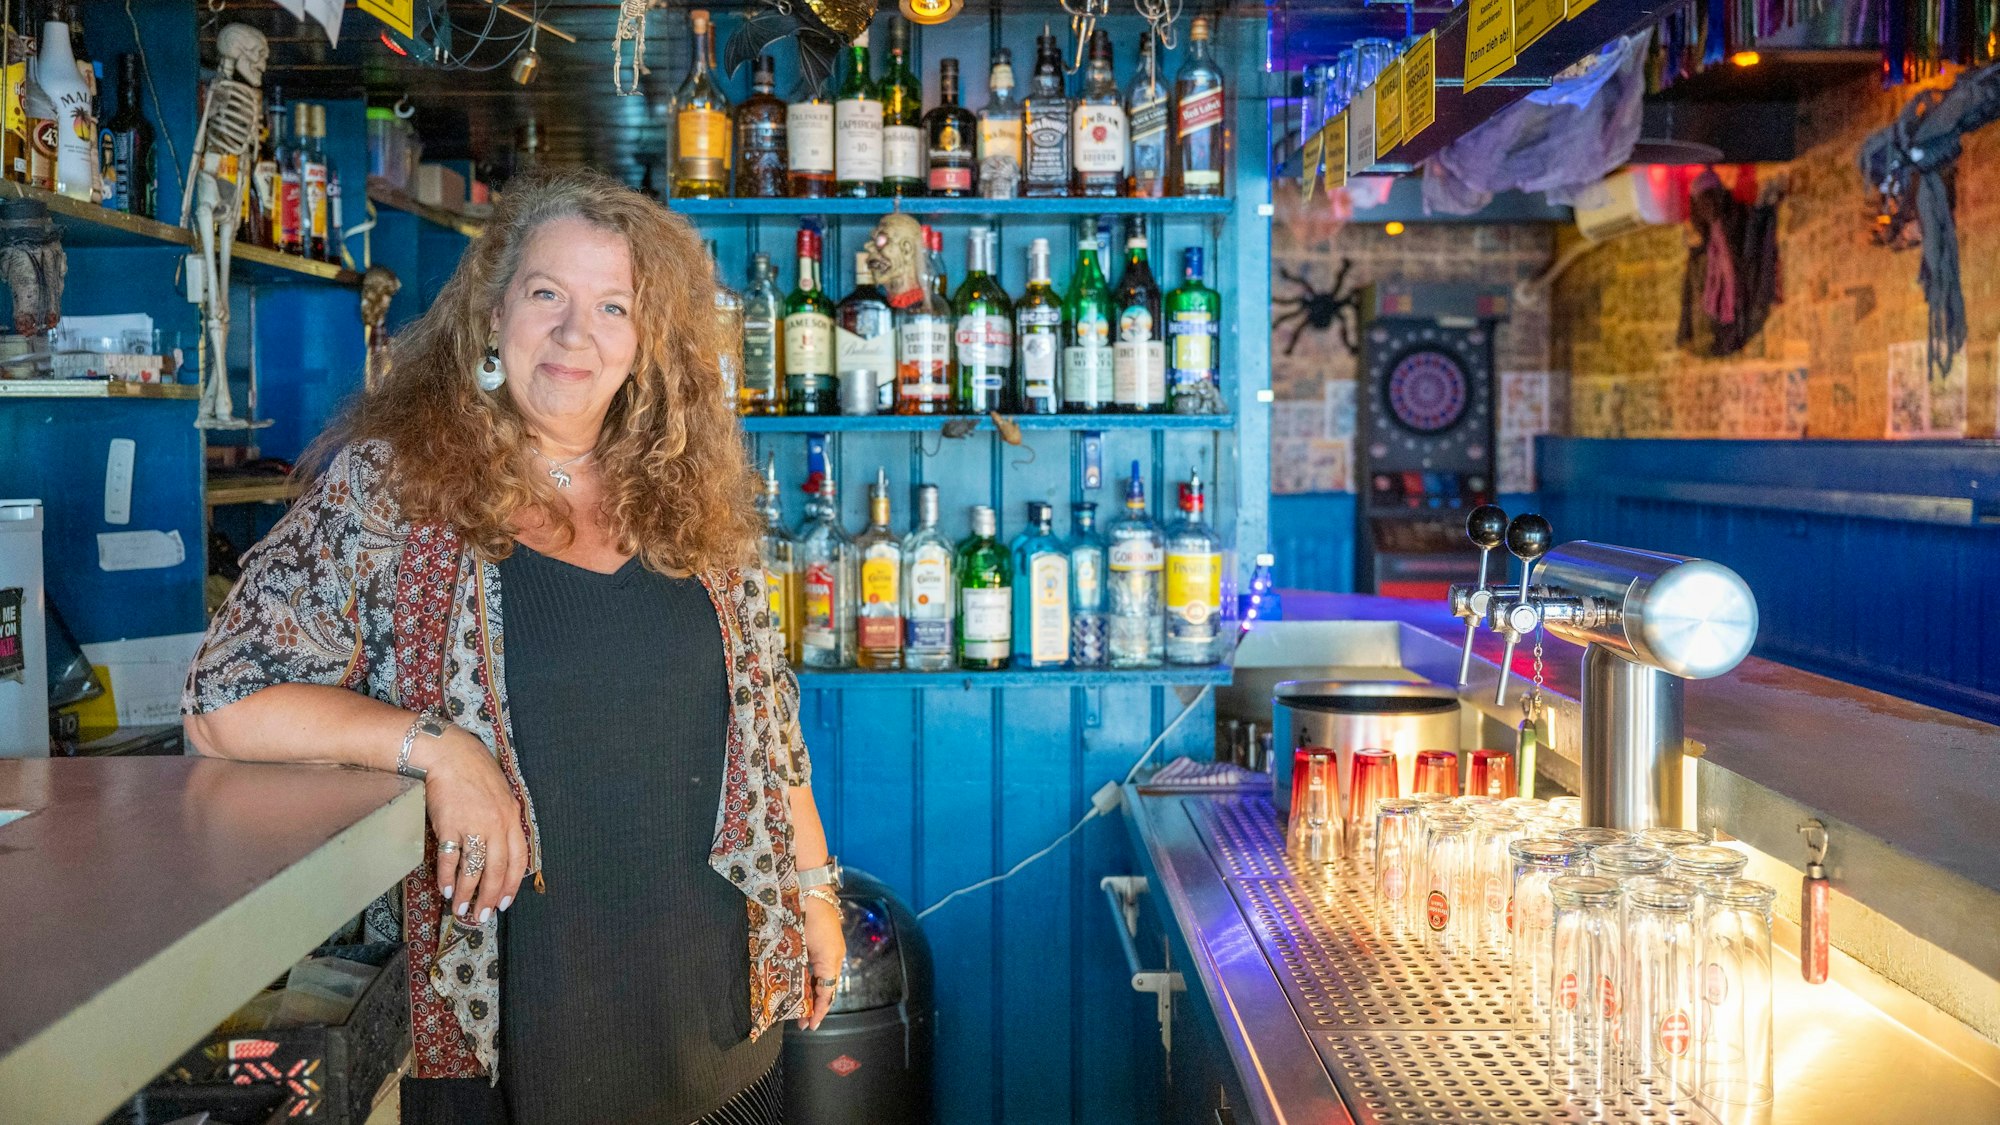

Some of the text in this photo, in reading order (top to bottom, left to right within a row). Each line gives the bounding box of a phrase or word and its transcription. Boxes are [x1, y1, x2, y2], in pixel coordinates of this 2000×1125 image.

[1470, 27, 1510, 63] Dann zieh ab!
[42, 128, 57, 147] 43
[3, 605, 17, 622] ME
[4, 621, 17, 637] ON
